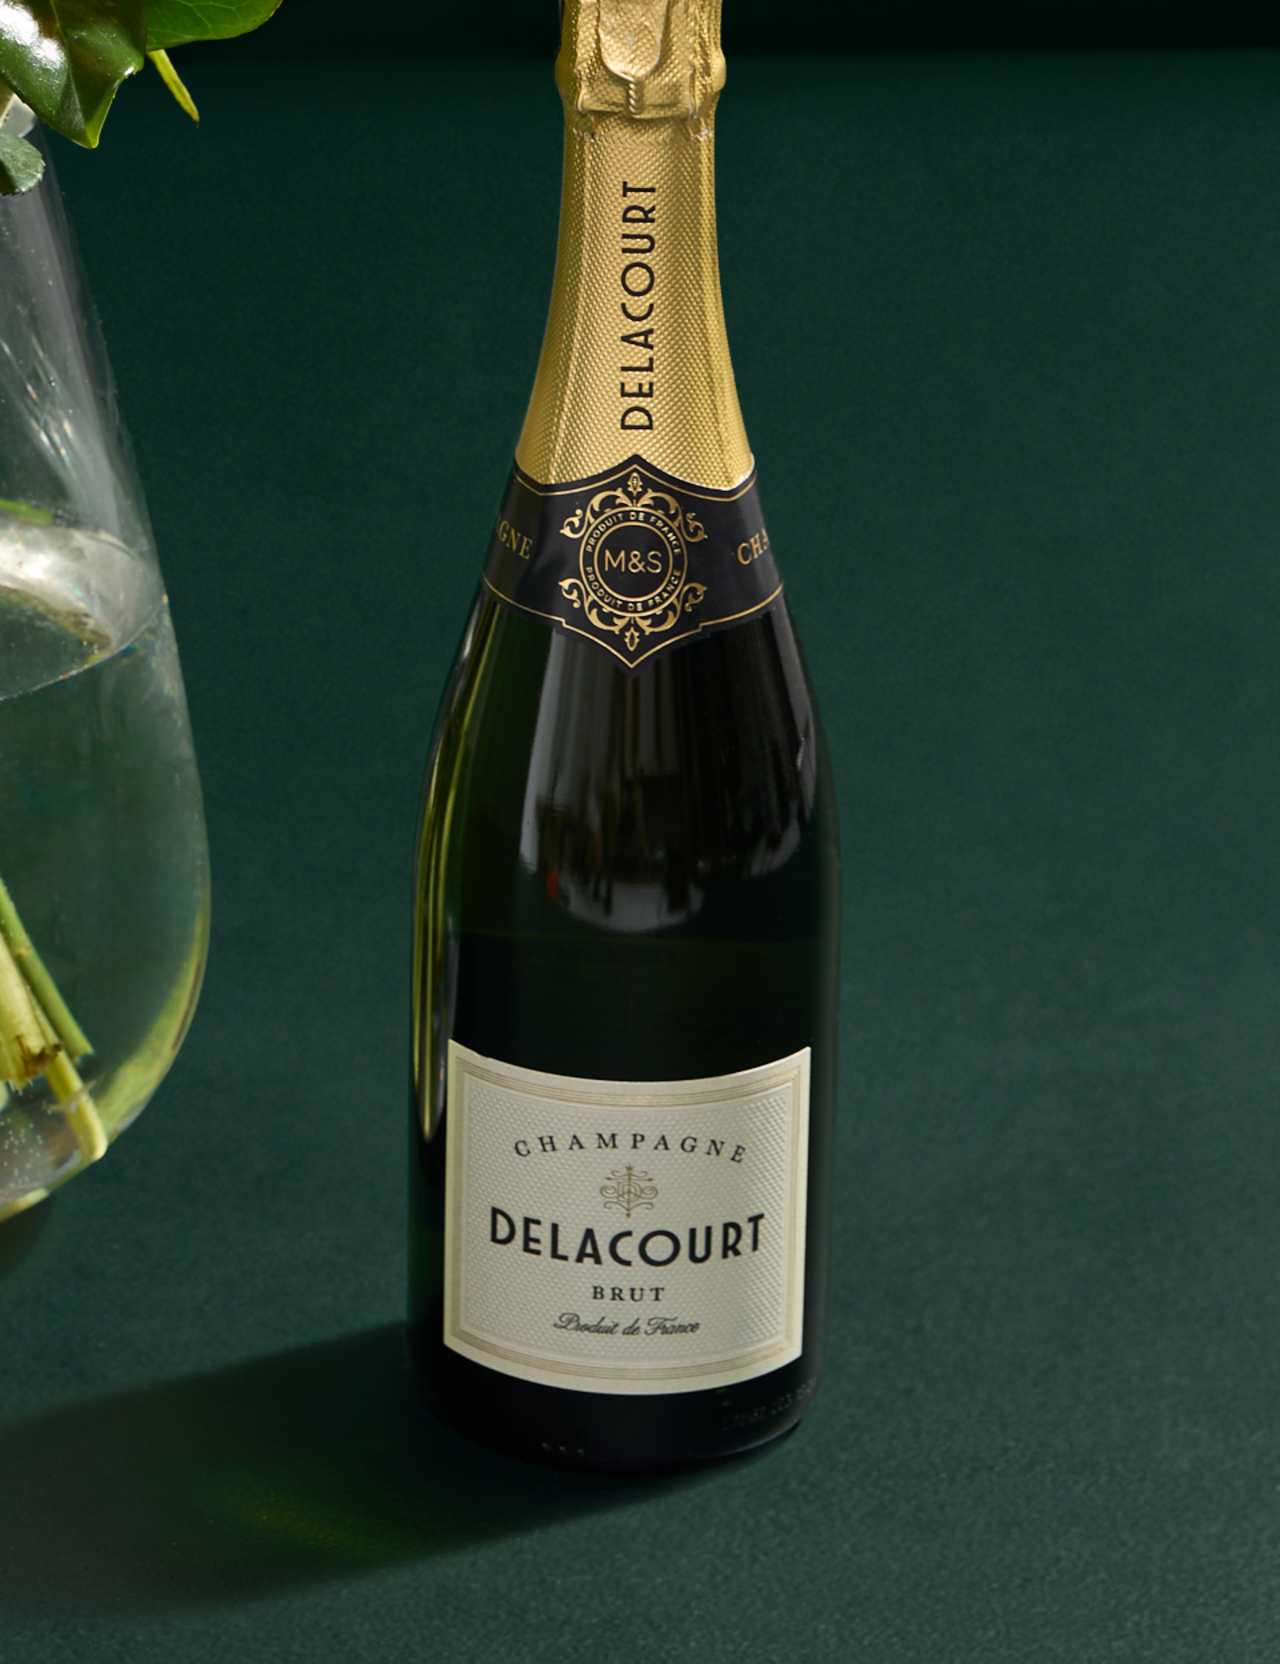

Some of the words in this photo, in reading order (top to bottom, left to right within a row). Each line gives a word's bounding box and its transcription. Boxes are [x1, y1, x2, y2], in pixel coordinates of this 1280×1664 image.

[620, 181, 657, 431] DELACOURT
[585, 512, 624, 553] PRODUIT
[629, 511, 646, 521] DE
[649, 513, 682, 553] FRANCE
[604, 548, 663, 574] M&S
[585, 566, 624, 608] PRODUIT
[627, 602, 644, 612] DE
[648, 570, 682, 607] FRANCE
[513, 1131, 748, 1165] CHAMPAGNE
[489, 1206, 766, 1268] DELACOURT
[591, 1285, 665, 1302] BRUT
[553, 1312, 619, 1336] Produit
[622, 1318, 640, 1336] de
[643, 1316, 701, 1336] France
